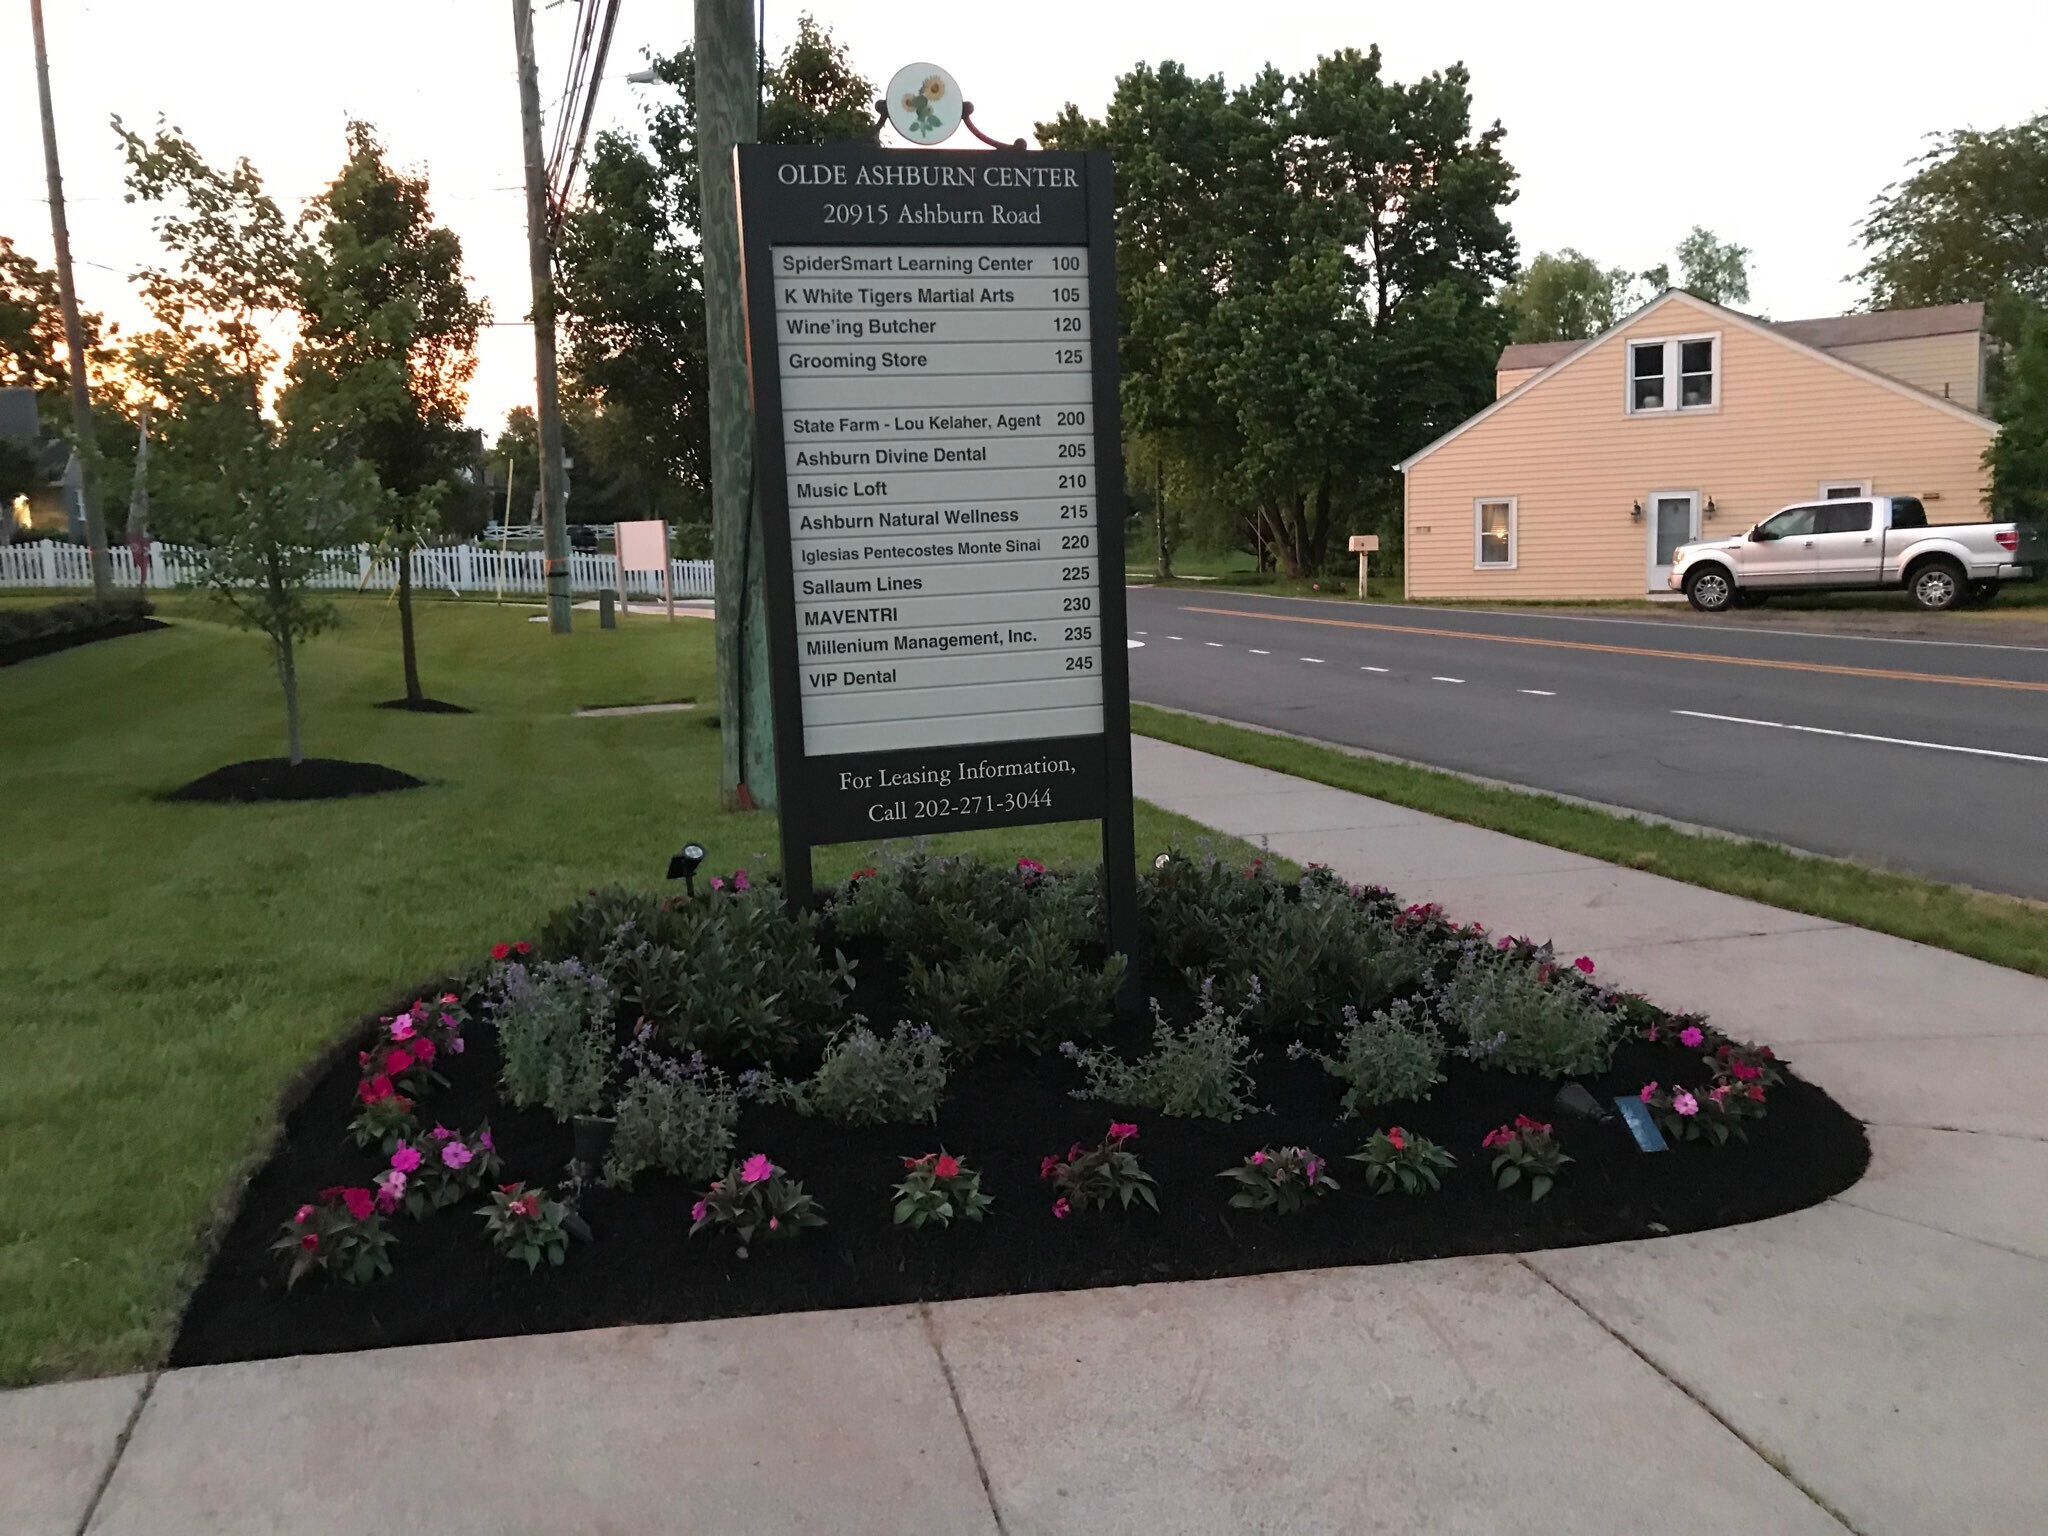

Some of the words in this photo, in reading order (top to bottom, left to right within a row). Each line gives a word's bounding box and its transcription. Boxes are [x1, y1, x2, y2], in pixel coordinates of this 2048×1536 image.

[777, 164, 847, 185] OLDE
[855, 166, 976, 186] ASHBURN
[983, 167, 1079, 187] CENTER
[823, 204, 889, 225] 20915
[897, 203, 984, 225] Ashburn
[992, 204, 1041, 225] Road
[782, 255, 893, 274] SpiderSmart
[898, 256, 973, 274] Learning
[978, 256, 1034, 272] Center
[1052, 256, 1080, 272] 100
[784, 288, 798, 304] K
[802, 288, 853, 304] White
[857, 288, 912, 308] Tigers
[917, 288, 975, 304] Martial
[979, 288, 1015, 303] Arts
[1052, 287, 1080, 303] 105
[786, 318, 864, 337] Wine'ing
[869, 318, 936, 334] Butcher
[1053, 317, 1081, 333] 120
[788, 353, 876, 372] Grooming
[881, 352, 928, 368] Store
[1055, 349, 1083, 365] 125
[793, 419, 834, 434] State
[840, 418, 880, 433] Farm
[894, 417, 925, 431] Lou
[929, 415, 992, 430] Kelaher,
[996, 414, 1041, 430] Agent
[1057, 411, 1086, 426] 200
[795, 449, 870, 466] Ashburn
[876, 448, 929, 464] Divine
[933, 447, 987, 462] Dental
[1058, 443, 1086, 458] 205
[797, 482, 848, 498] Music
[853, 481, 888, 496] Loft
[1058, 474, 1087, 489] 210
[800, 514, 874, 531] Ashburn
[879, 511, 939, 528] Natural
[944, 509, 1019, 525] Wellness
[1060, 504, 1088, 520] 215
[801, 547, 859, 564] Iglesias
[864, 543, 954, 561] Pentecostes
[958, 541, 1002, 556] Monte
[1006, 539, 1041, 553] Sinai
[1061, 535, 1090, 550] 220
[802, 578, 872, 595] Sallaum
[877, 576, 923, 592] Lines
[1062, 566, 1090, 581] 225
[804, 607, 898, 626] MAVENTRI
[1063, 597, 1091, 612] 230
[806, 638, 889, 656] Millenium
[894, 630, 1004, 651] Management,
[1008, 629, 1037, 644] Inc.
[1064, 626, 1092, 642] 235
[809, 673, 838, 688] VIP
[843, 668, 896, 686] Dental
[1065, 656, 1093, 670] 245
[839, 772, 873, 790] For
[879, 766, 951, 787] Leasing
[958, 756, 1076, 781] Information,
[868, 802, 906, 823] Call
[914, 788, 1052, 819] 202-271-3044
